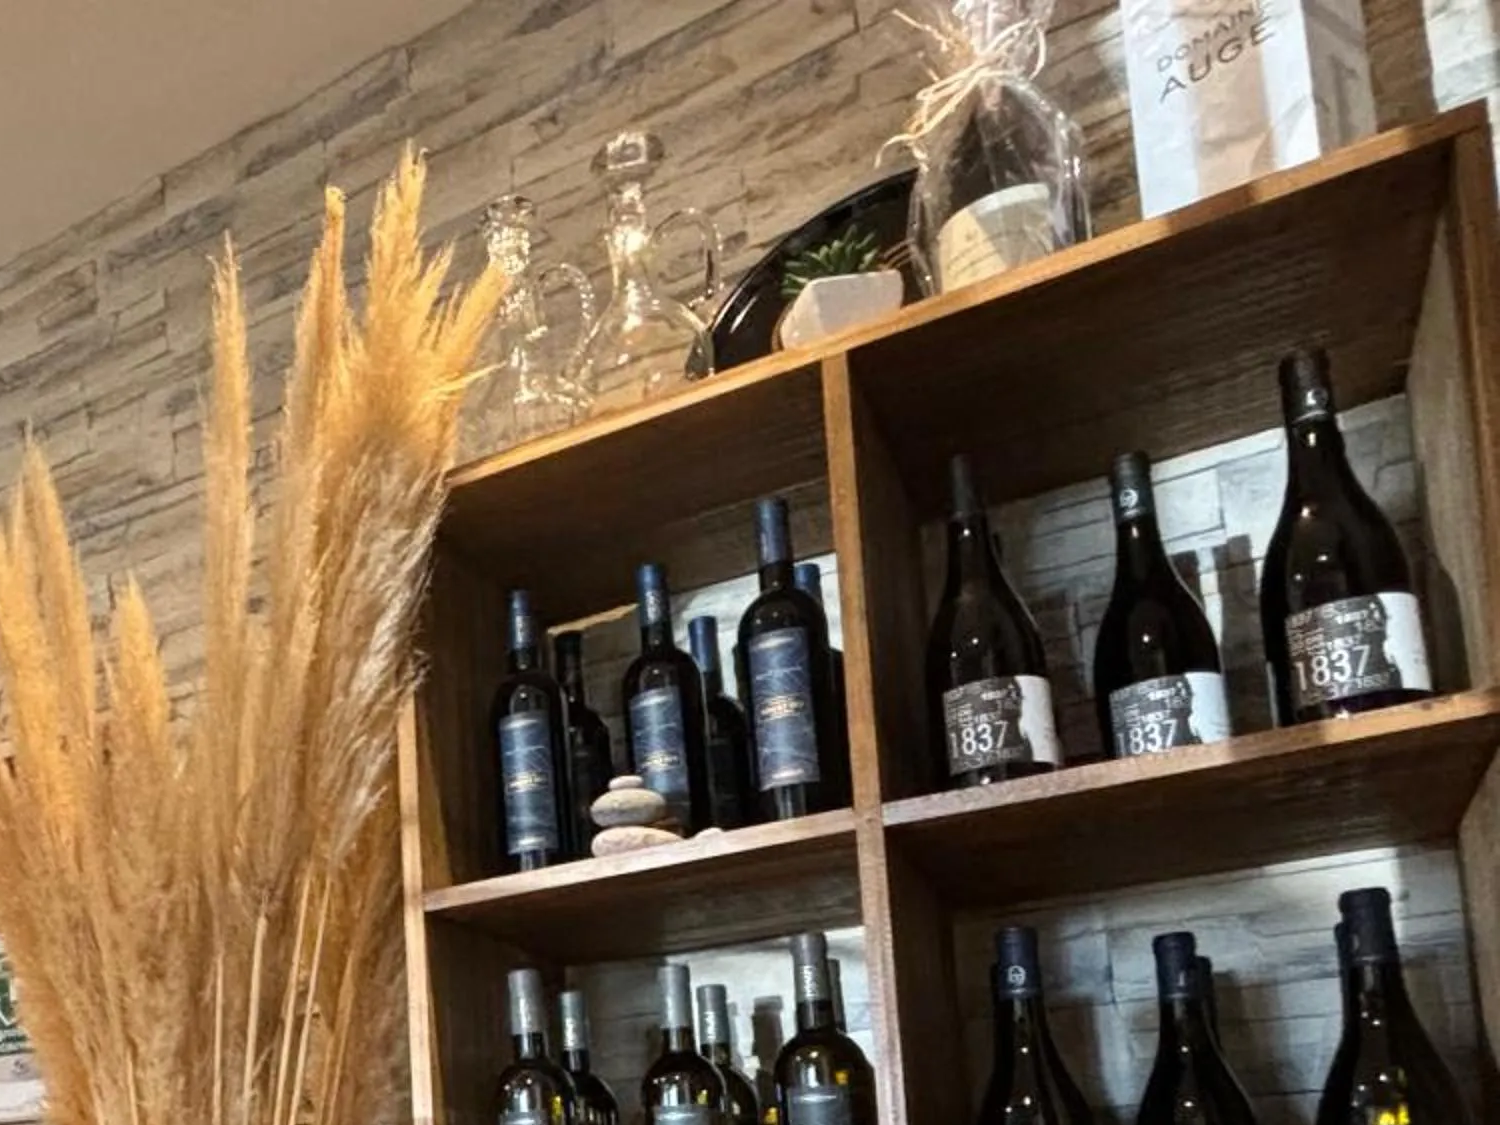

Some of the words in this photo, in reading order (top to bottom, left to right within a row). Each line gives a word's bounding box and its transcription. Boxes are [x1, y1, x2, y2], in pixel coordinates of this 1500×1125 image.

[1293, 645, 1371, 691] 1837
[950, 721, 1009, 759] 1837
[1116, 719, 1177, 757] 1837
